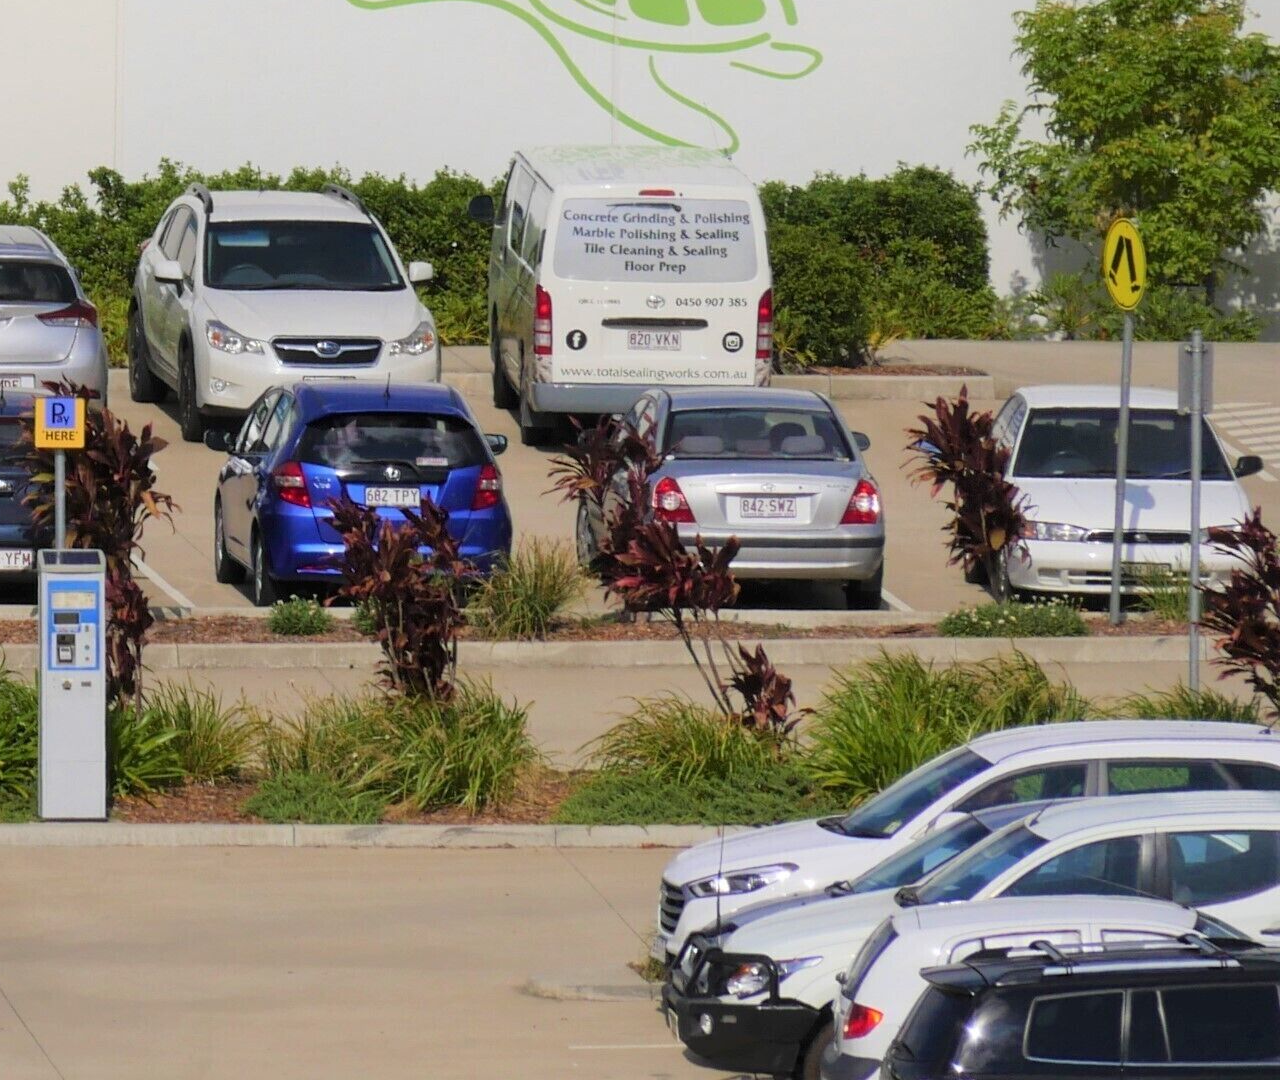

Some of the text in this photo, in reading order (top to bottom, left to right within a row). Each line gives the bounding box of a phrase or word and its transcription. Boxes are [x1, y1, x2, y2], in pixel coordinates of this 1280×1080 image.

[563, 210, 750, 226] Concrete Grinding & Polishing
[573, 226, 739, 242] Marble Polishing & Sealing
[584, 243, 728, 258] Tile Cleaning & Sealing
[624, 261, 686, 274] Floor Prep
[675, 297, 748, 307] 0450 907 385
[655, 333, 679, 345] VKN
[560, 367, 747, 381] www.totalsealingworks.com.au
[51, 402, 70, 426] Pay
[395, 490, 419, 503] TPY
[742, 499, 795, 513] 842 SWZ
